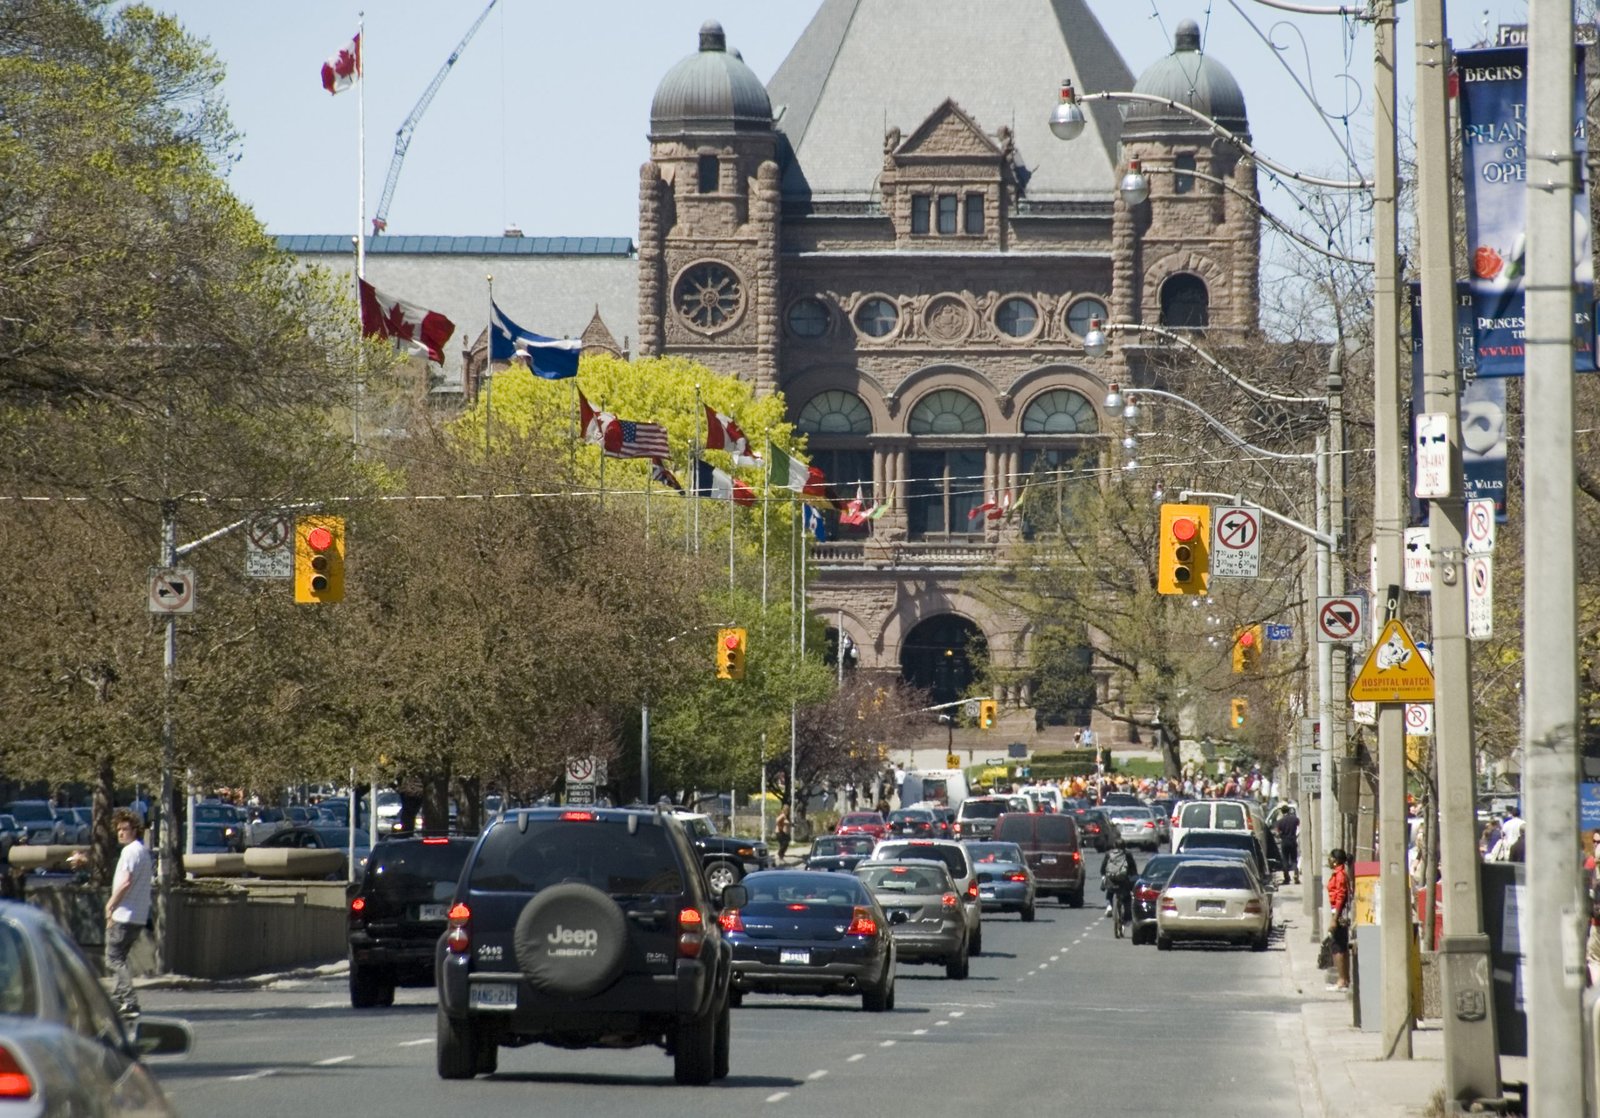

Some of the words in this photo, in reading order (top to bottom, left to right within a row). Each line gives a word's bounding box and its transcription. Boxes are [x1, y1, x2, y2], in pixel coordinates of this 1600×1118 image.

[1465, 66, 1522, 82] BEGINS
[1483, 162, 1528, 183] OPE
[1478, 317, 1526, 330] PRINCES
[1474, 479, 1503, 488] WALES
[1415, 571, 1432, 583] ZON
[1361, 677, 1399, 687] HOSPITAL
[1402, 677, 1430, 686] WATCH
[548, 925, 598, 947] Jeep
